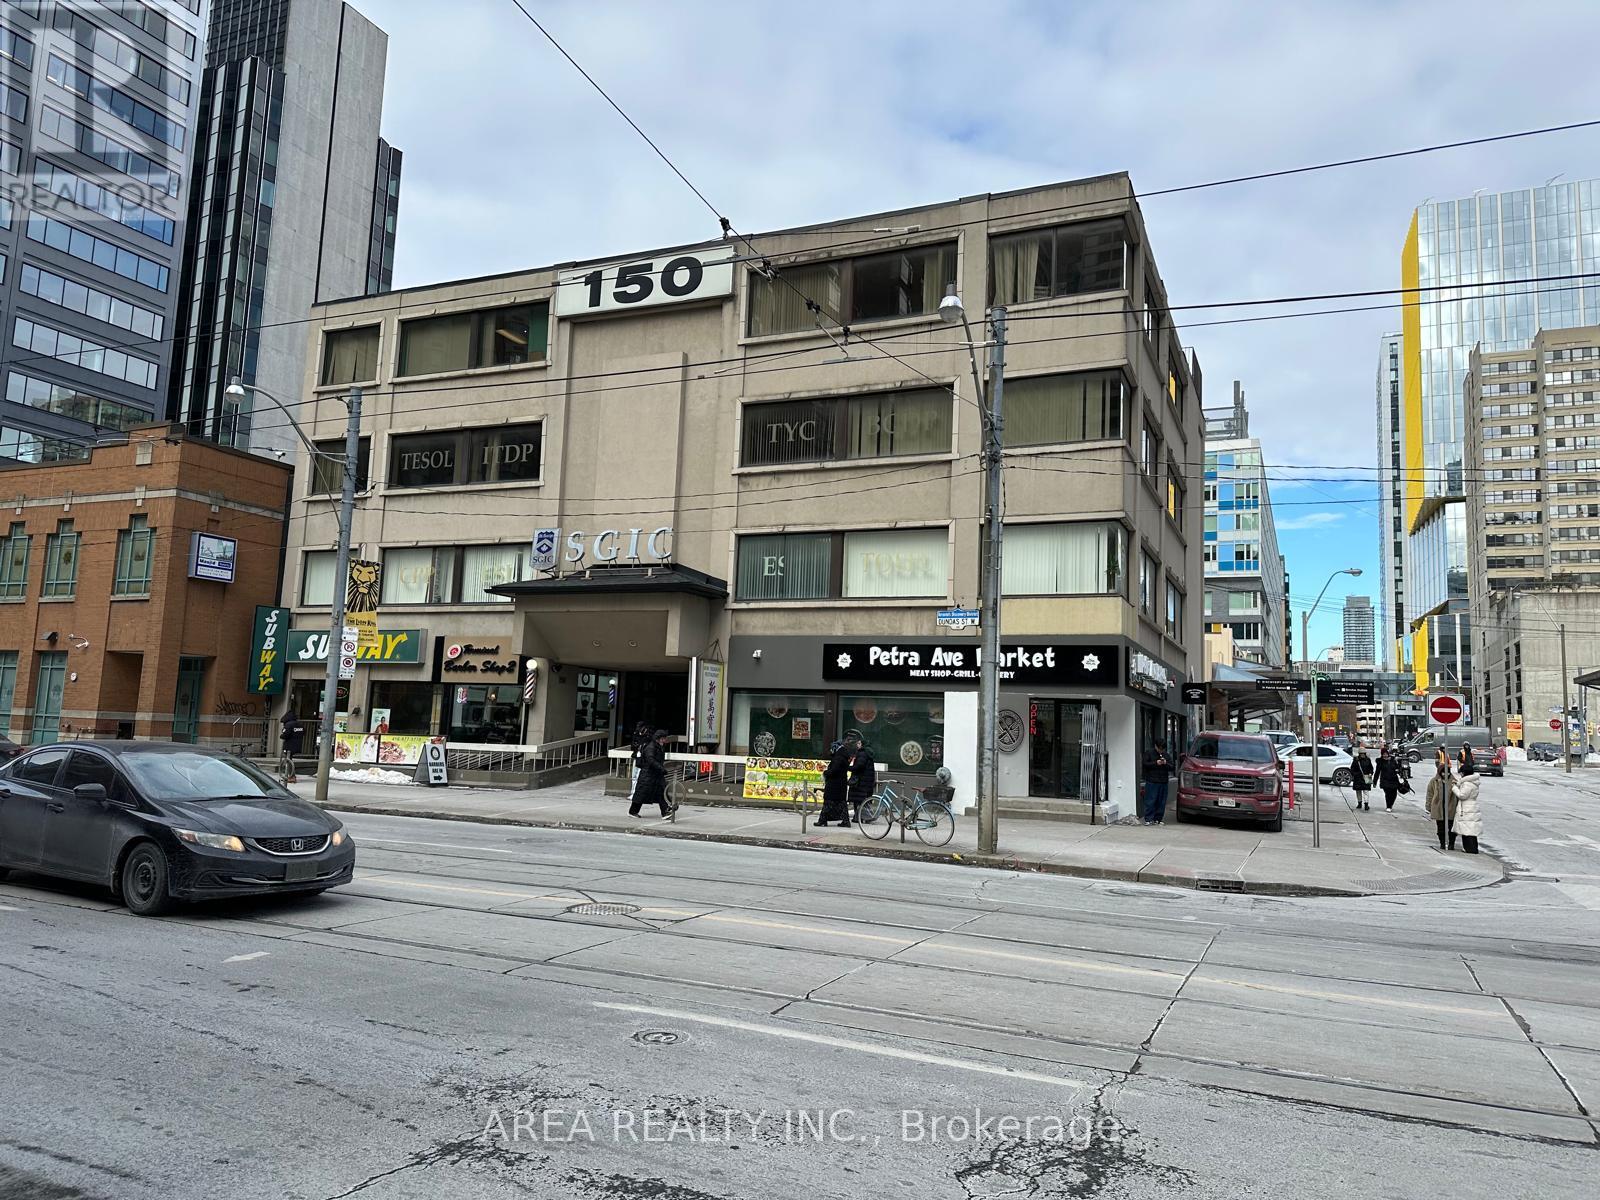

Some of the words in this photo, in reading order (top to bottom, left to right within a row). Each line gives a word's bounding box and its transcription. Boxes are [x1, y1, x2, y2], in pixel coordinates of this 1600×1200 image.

[584, 256, 704, 308] 150
[767, 420, 816, 443] TYC
[402, 450, 453, 470] TESOL
[482, 443, 534, 465] ITDP
[565, 527, 674, 562] SGIC
[532, 555, 554, 564] SGIC
[258, 609, 280, 691] SUBWAY
[869, 646, 920, 667] Petra
[930, 647, 964, 667] Ave
[976, 646, 1056, 668] arket
[443, 660, 477, 673] Barber
[909, 669, 930, 677] MEAT
[1030, 703, 1038, 735] OPEN
